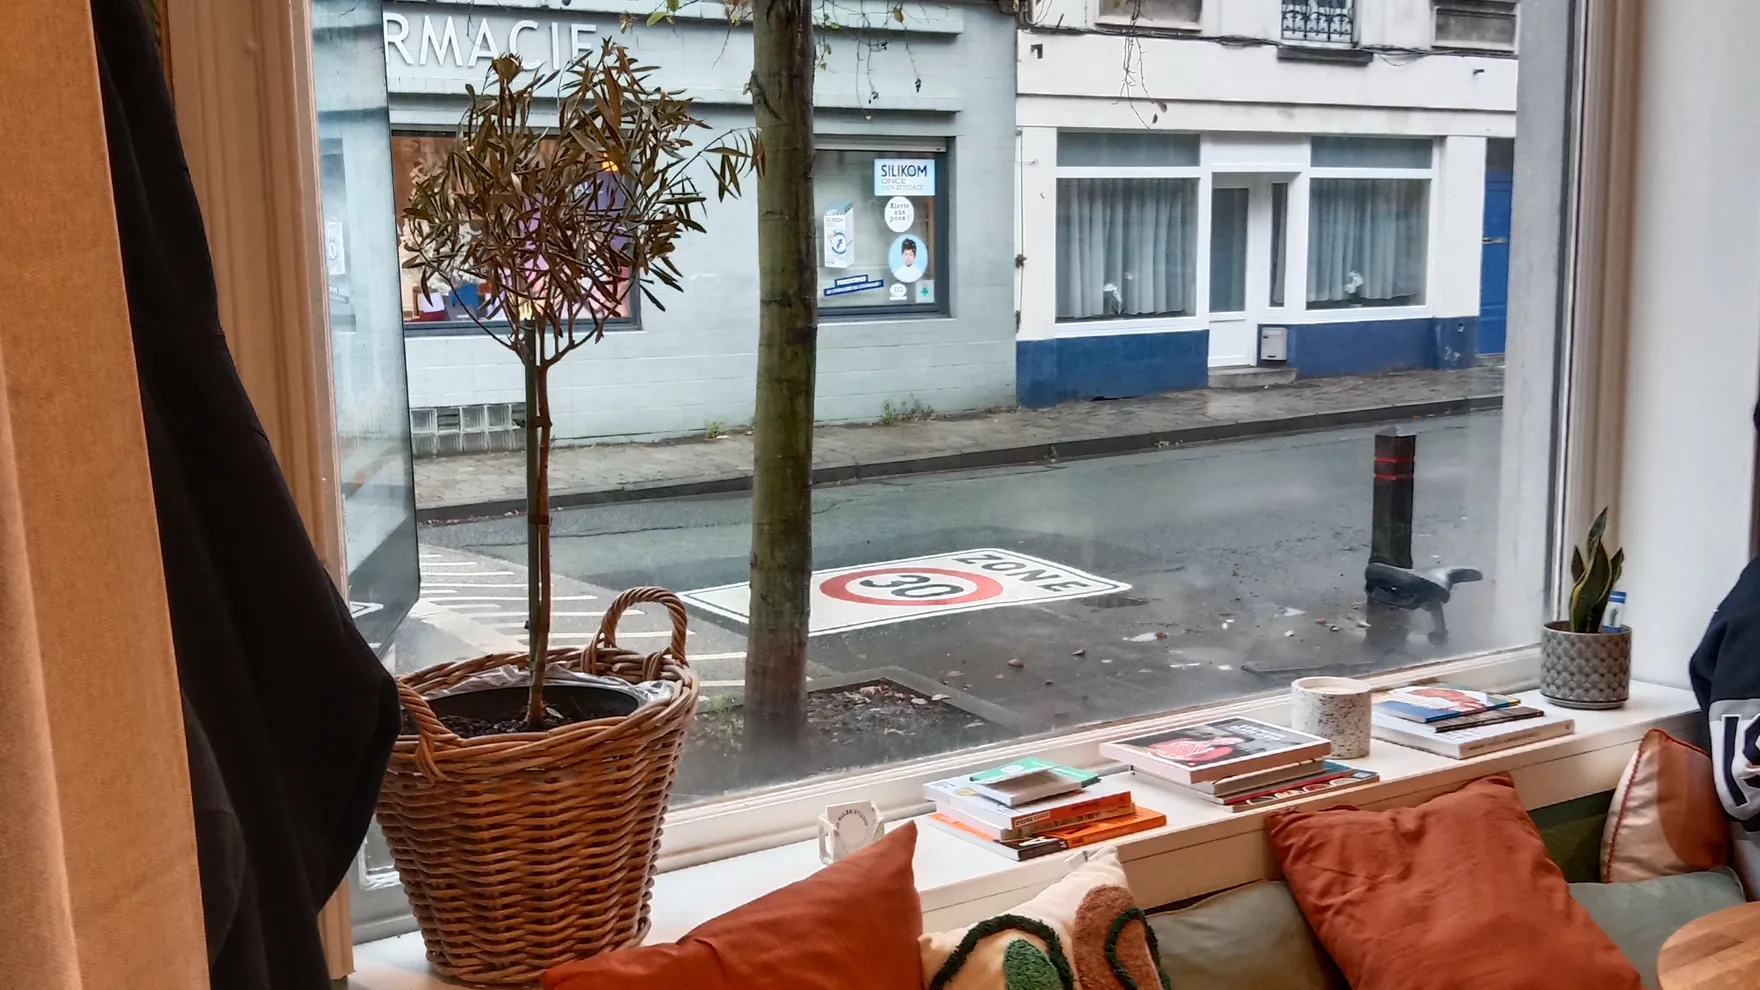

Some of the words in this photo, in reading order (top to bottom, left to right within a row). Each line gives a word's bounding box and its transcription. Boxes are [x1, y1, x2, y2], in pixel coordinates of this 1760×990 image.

[881, 164, 928, 177] SILIKOM
[881, 177, 907, 185] ONCE
[952, 553, 1092, 593] ZONE
[859, 574, 965, 599] 30
